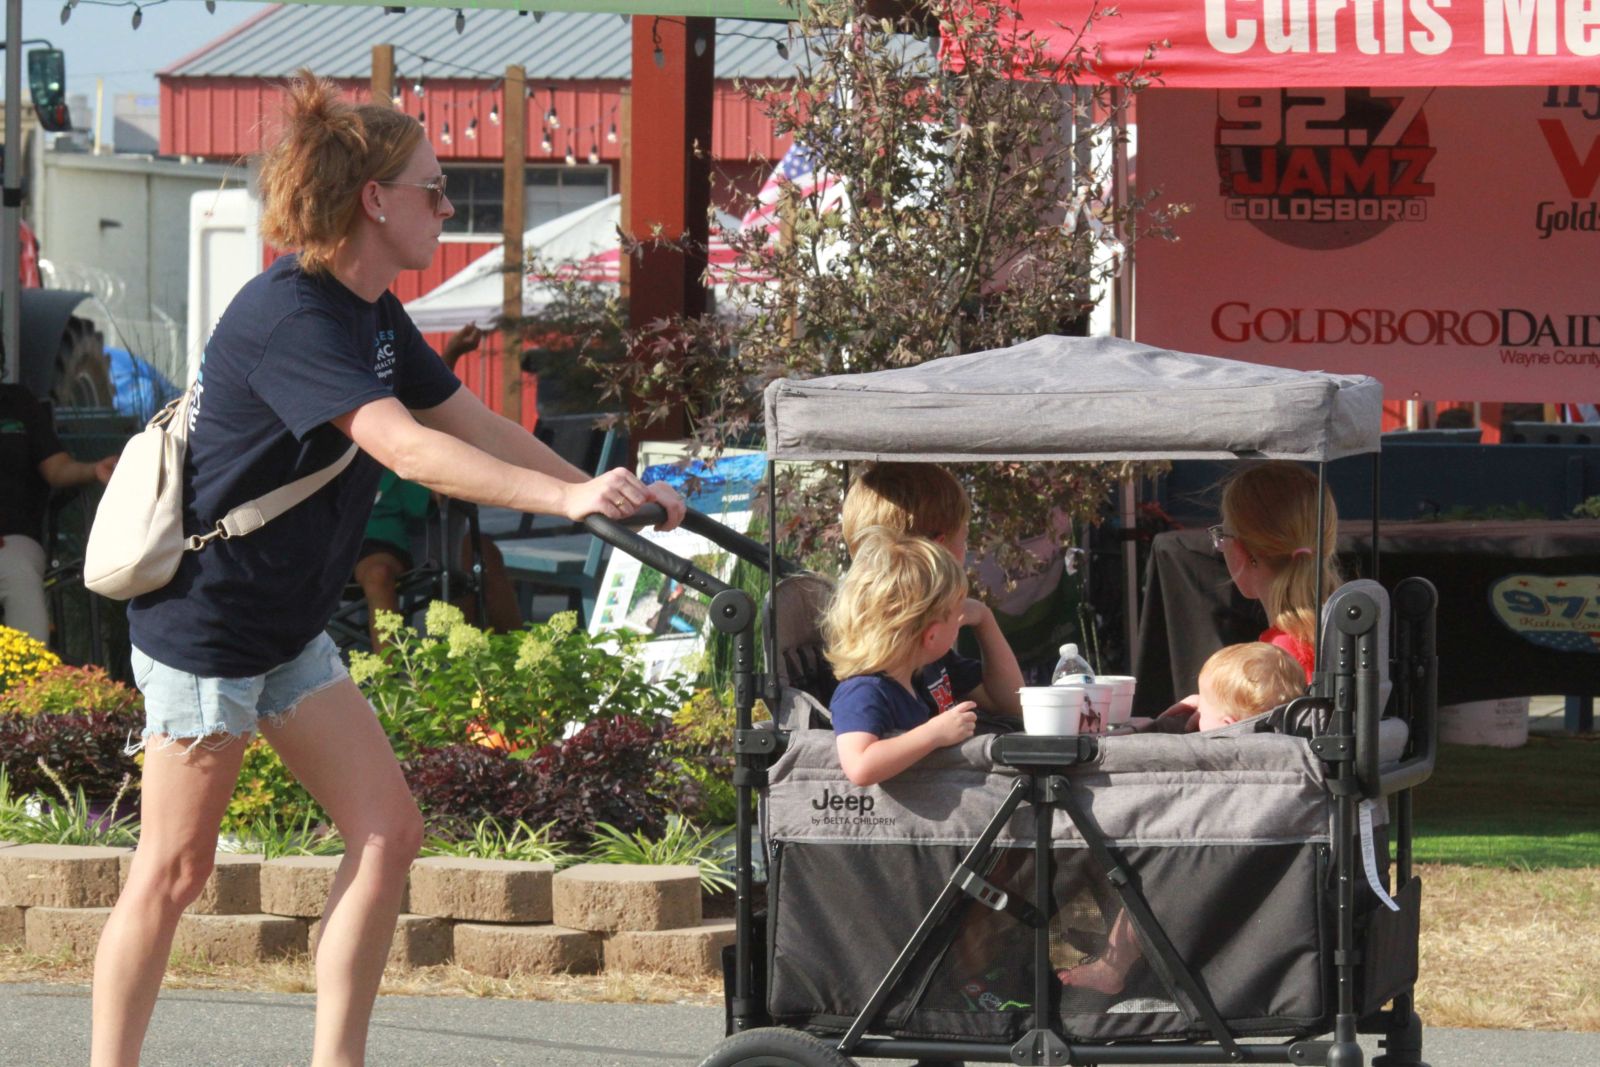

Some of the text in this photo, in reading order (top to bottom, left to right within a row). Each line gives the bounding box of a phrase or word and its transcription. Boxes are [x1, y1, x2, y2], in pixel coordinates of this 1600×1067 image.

[1205, 0, 1453, 54] Curtis
[1217, 87, 1437, 146] 92.7
[1231, 147, 1437, 197] JAMZ
[1224, 197, 1427, 221] GOLDSBORO
[1499, 350, 1600, 368] Wayne County
[812, 788, 875, 816] Jeep
[811, 816, 896, 826] by DELTA CHILDREN
